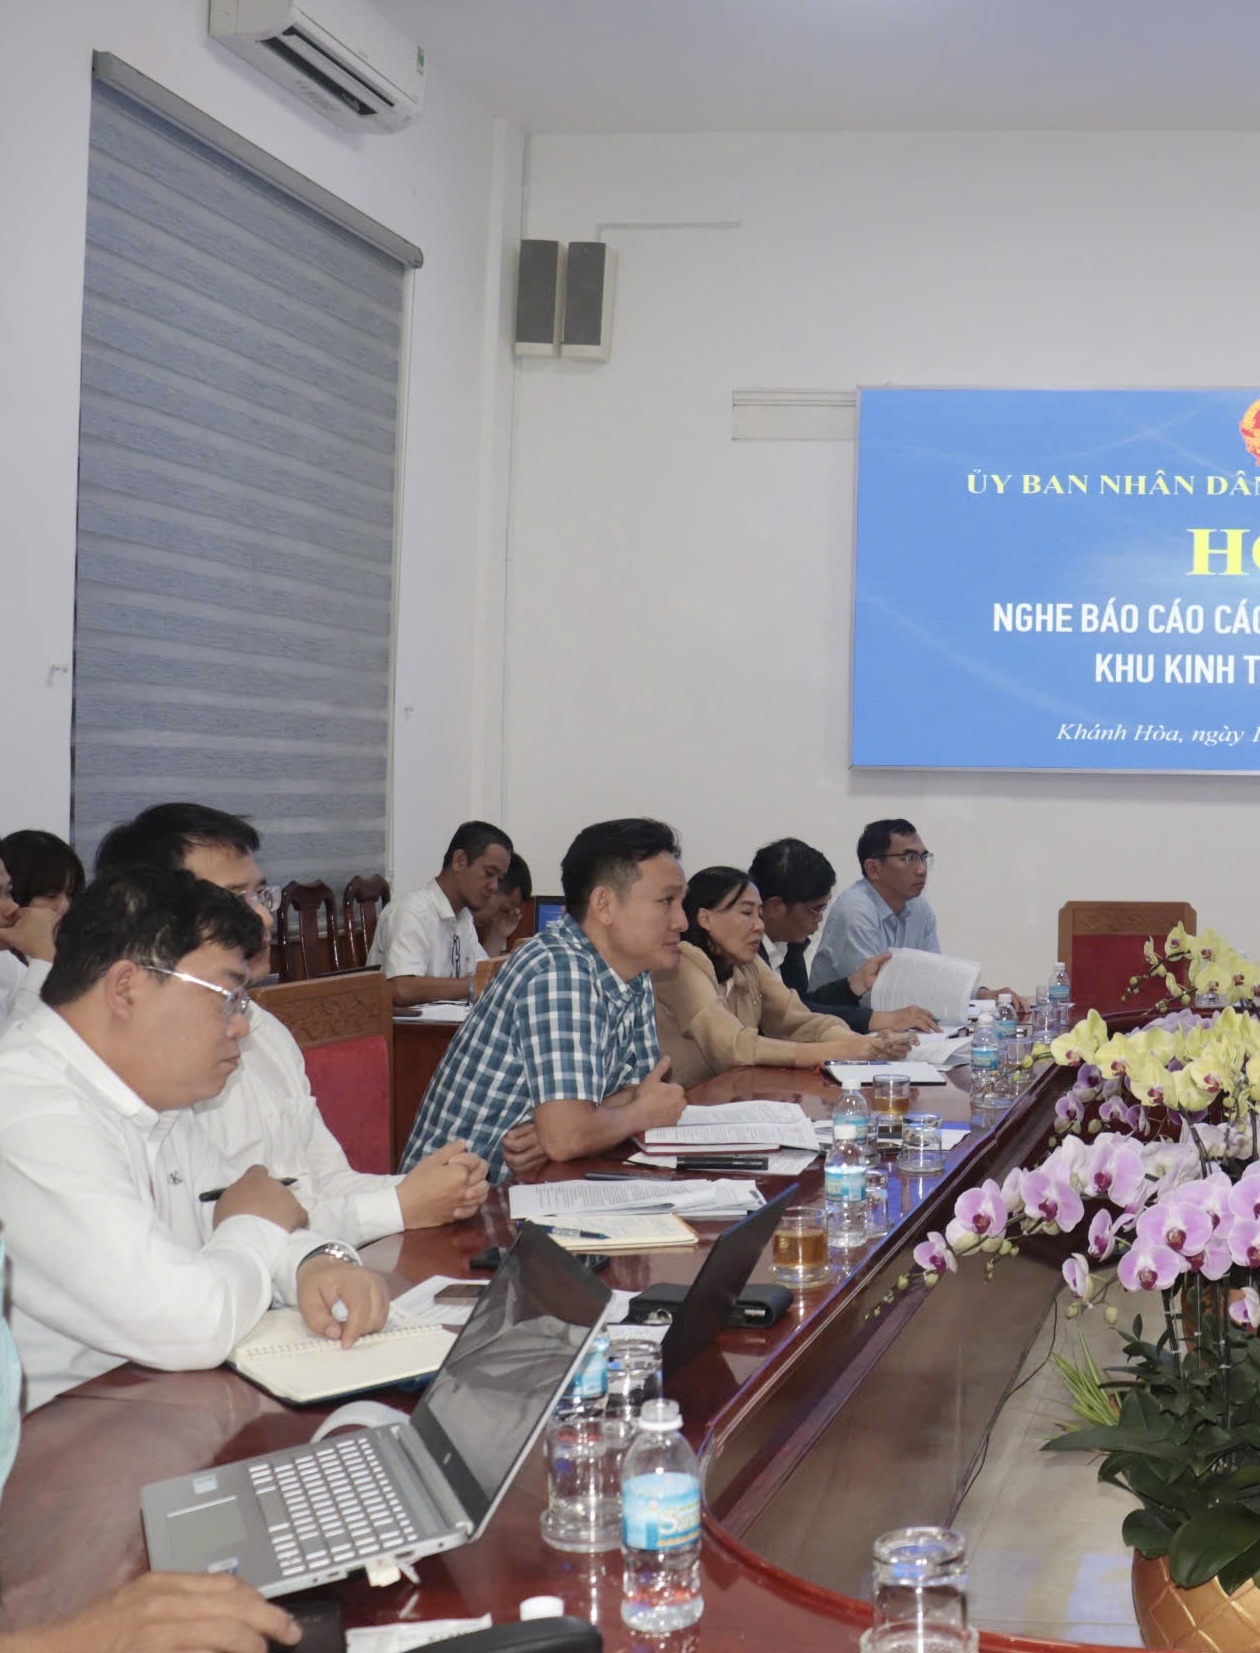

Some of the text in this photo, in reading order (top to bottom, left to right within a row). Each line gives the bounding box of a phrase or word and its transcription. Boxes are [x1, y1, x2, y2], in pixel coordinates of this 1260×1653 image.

[967, 469, 1012, 494] ỦY
[1022, 474, 1089, 494] BAN
[1099, 469, 1195, 495] NHÂN
[993, 602, 1073, 633] NGHE
[1081, 597, 1139, 634] BÁO
[1148, 598, 1204, 634] CÁO
[1095, 653, 1155, 684] KHU
[1164, 654, 1235, 685] KINH
[1056, 722, 1128, 741] Khánh
[1133, 723, 1184, 744] Hòa,
[1191, 724, 1245, 747] ngày
